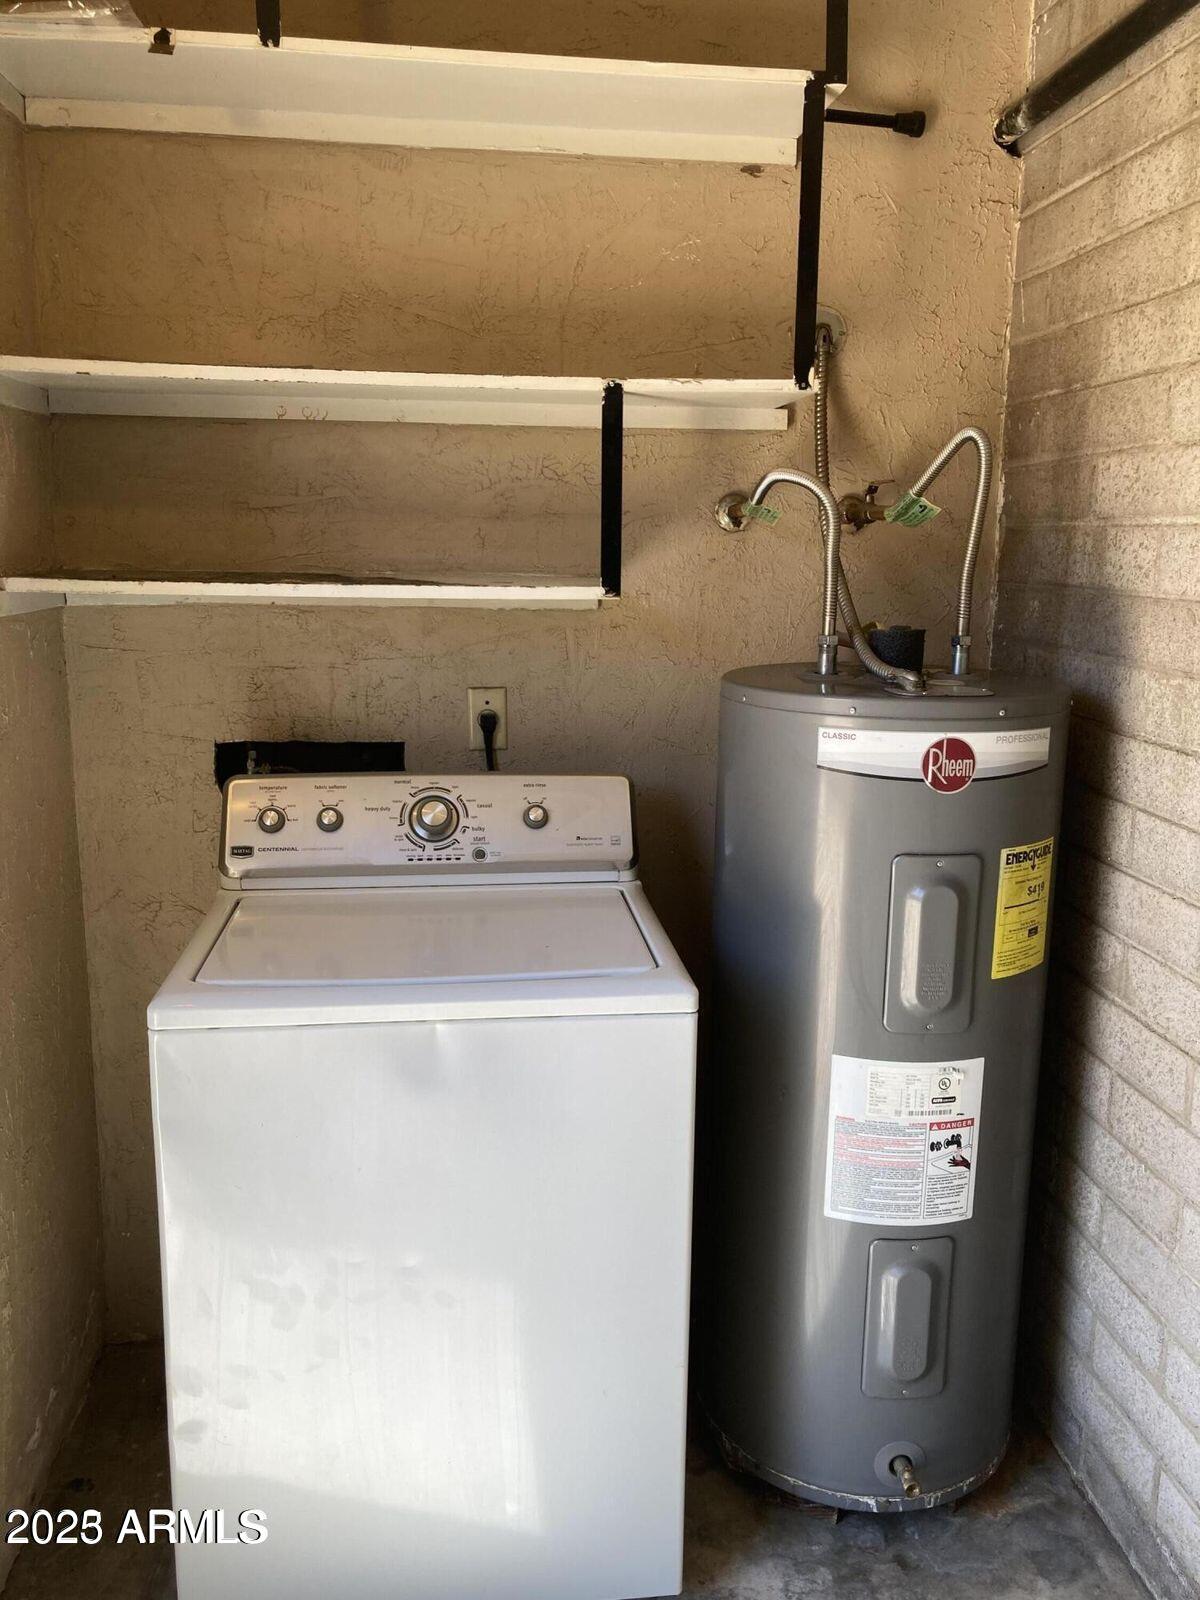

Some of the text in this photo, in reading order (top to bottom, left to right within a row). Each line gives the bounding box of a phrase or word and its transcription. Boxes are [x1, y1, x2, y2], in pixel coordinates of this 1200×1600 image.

[822, 732, 856, 740] CLASSIC
[996, 733, 1048, 744] PROFESSIONAL
[927, 734, 974, 785] Rheem
[1005, 843, 1052, 865] ENERGYGUIDE
[1027, 881, 1045, 897] $419
[941, 1120, 972, 1129] DANGER
